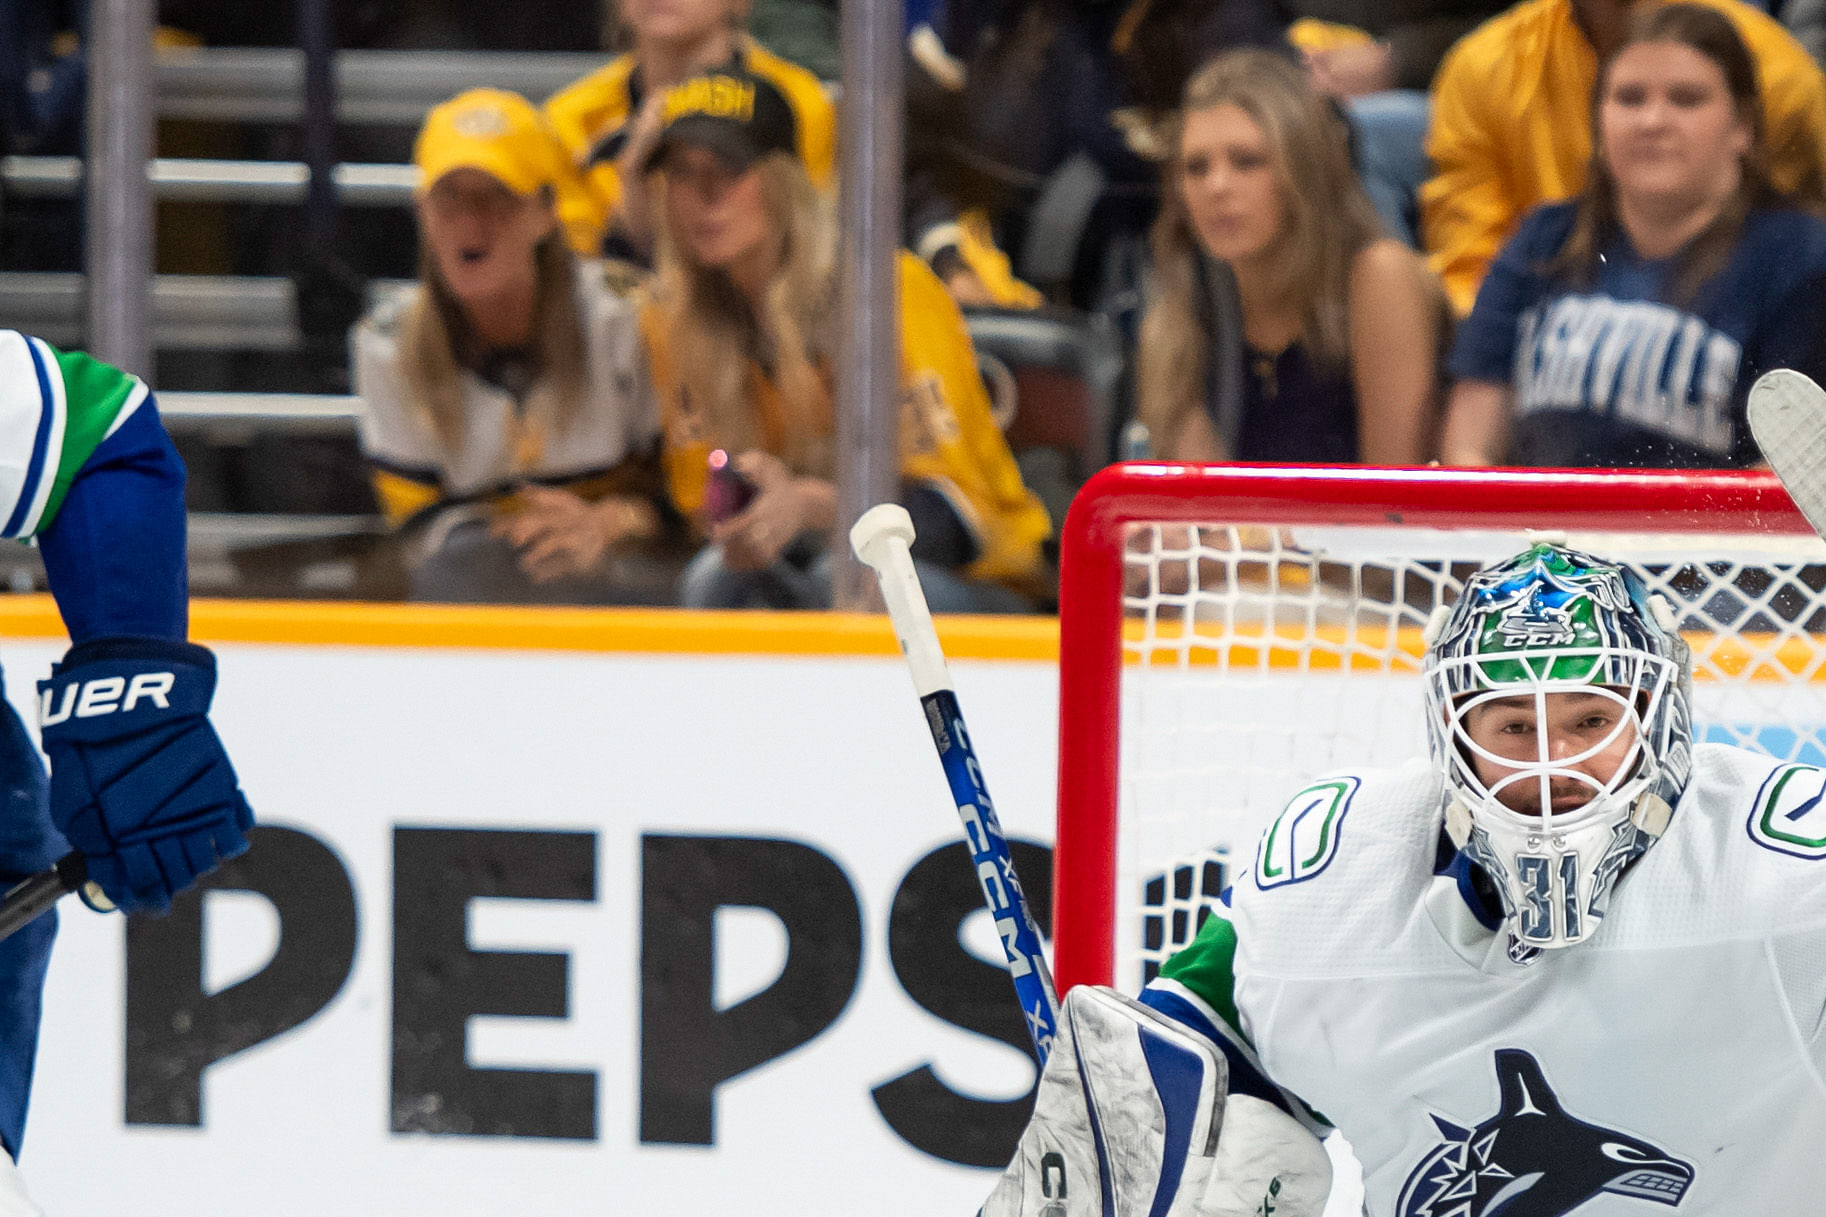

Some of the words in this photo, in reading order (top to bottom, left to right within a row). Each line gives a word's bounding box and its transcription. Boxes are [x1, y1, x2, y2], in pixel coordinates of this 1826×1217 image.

[1503, 633, 1576, 647] CCM
[34, 671, 176, 729] UER
[959, 803, 1034, 979] CCM
[1514, 849, 1583, 943] 31
